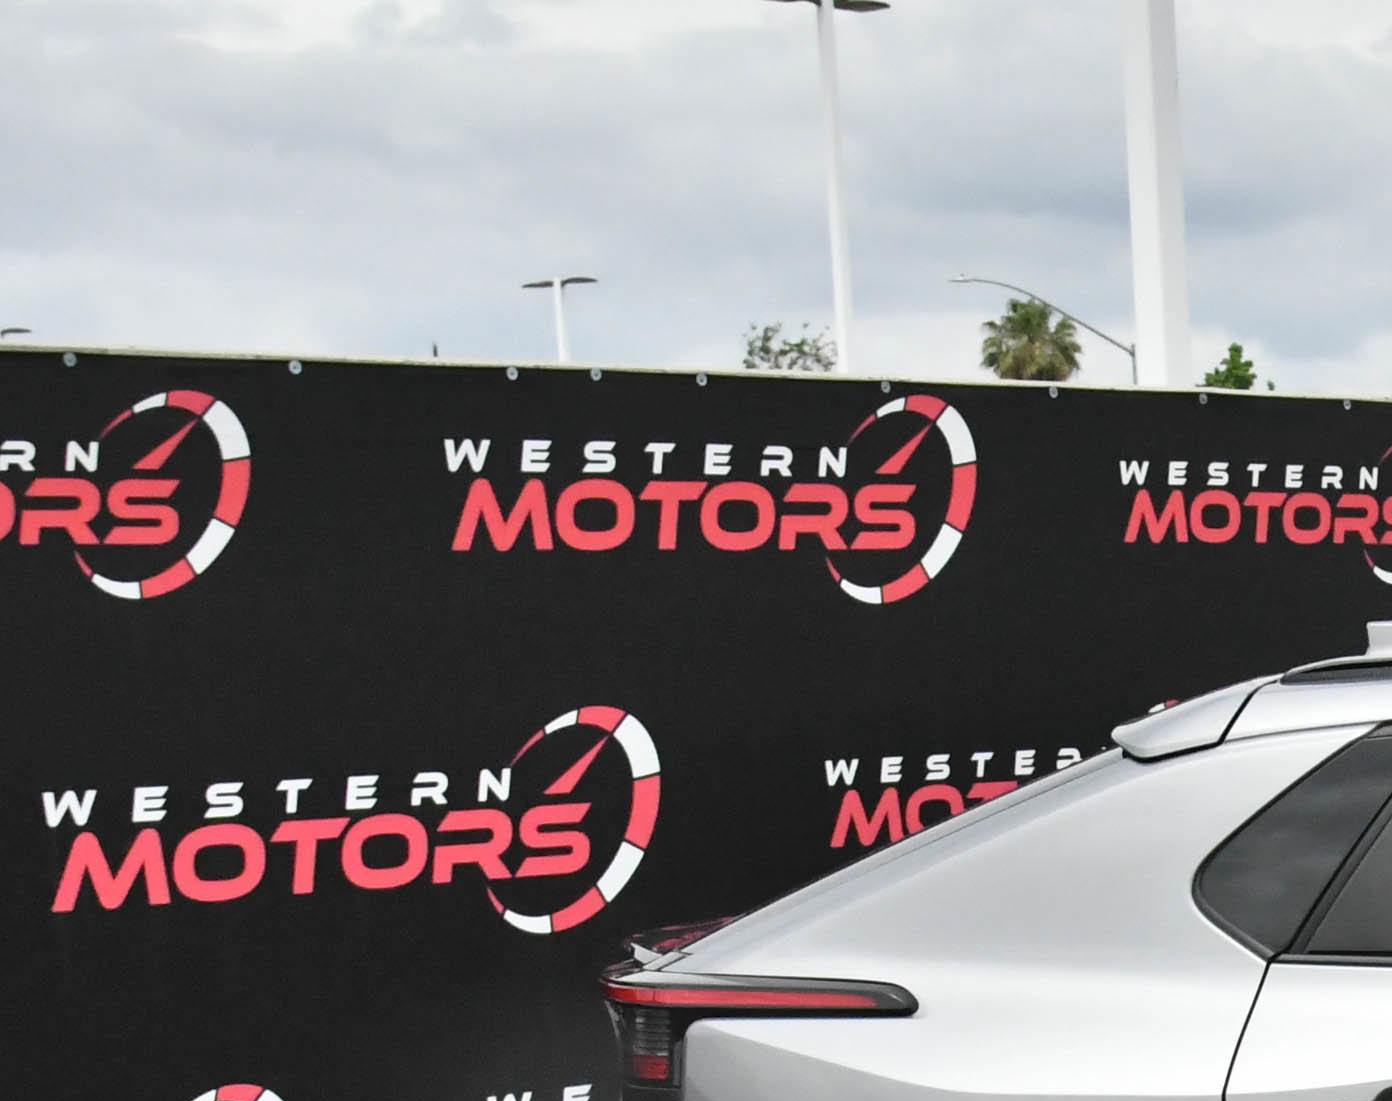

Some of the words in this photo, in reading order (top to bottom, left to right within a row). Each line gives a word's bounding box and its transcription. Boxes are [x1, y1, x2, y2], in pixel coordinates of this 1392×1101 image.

[442, 437, 849, 478] WESTERN
[1118, 459, 1380, 491] WESTERN
[0, 477, 181, 545] RS
[451, 476, 917, 552] MOTORS
[41, 767, 512, 828] WESTERN
[51, 801, 592, 913] MOTORS
